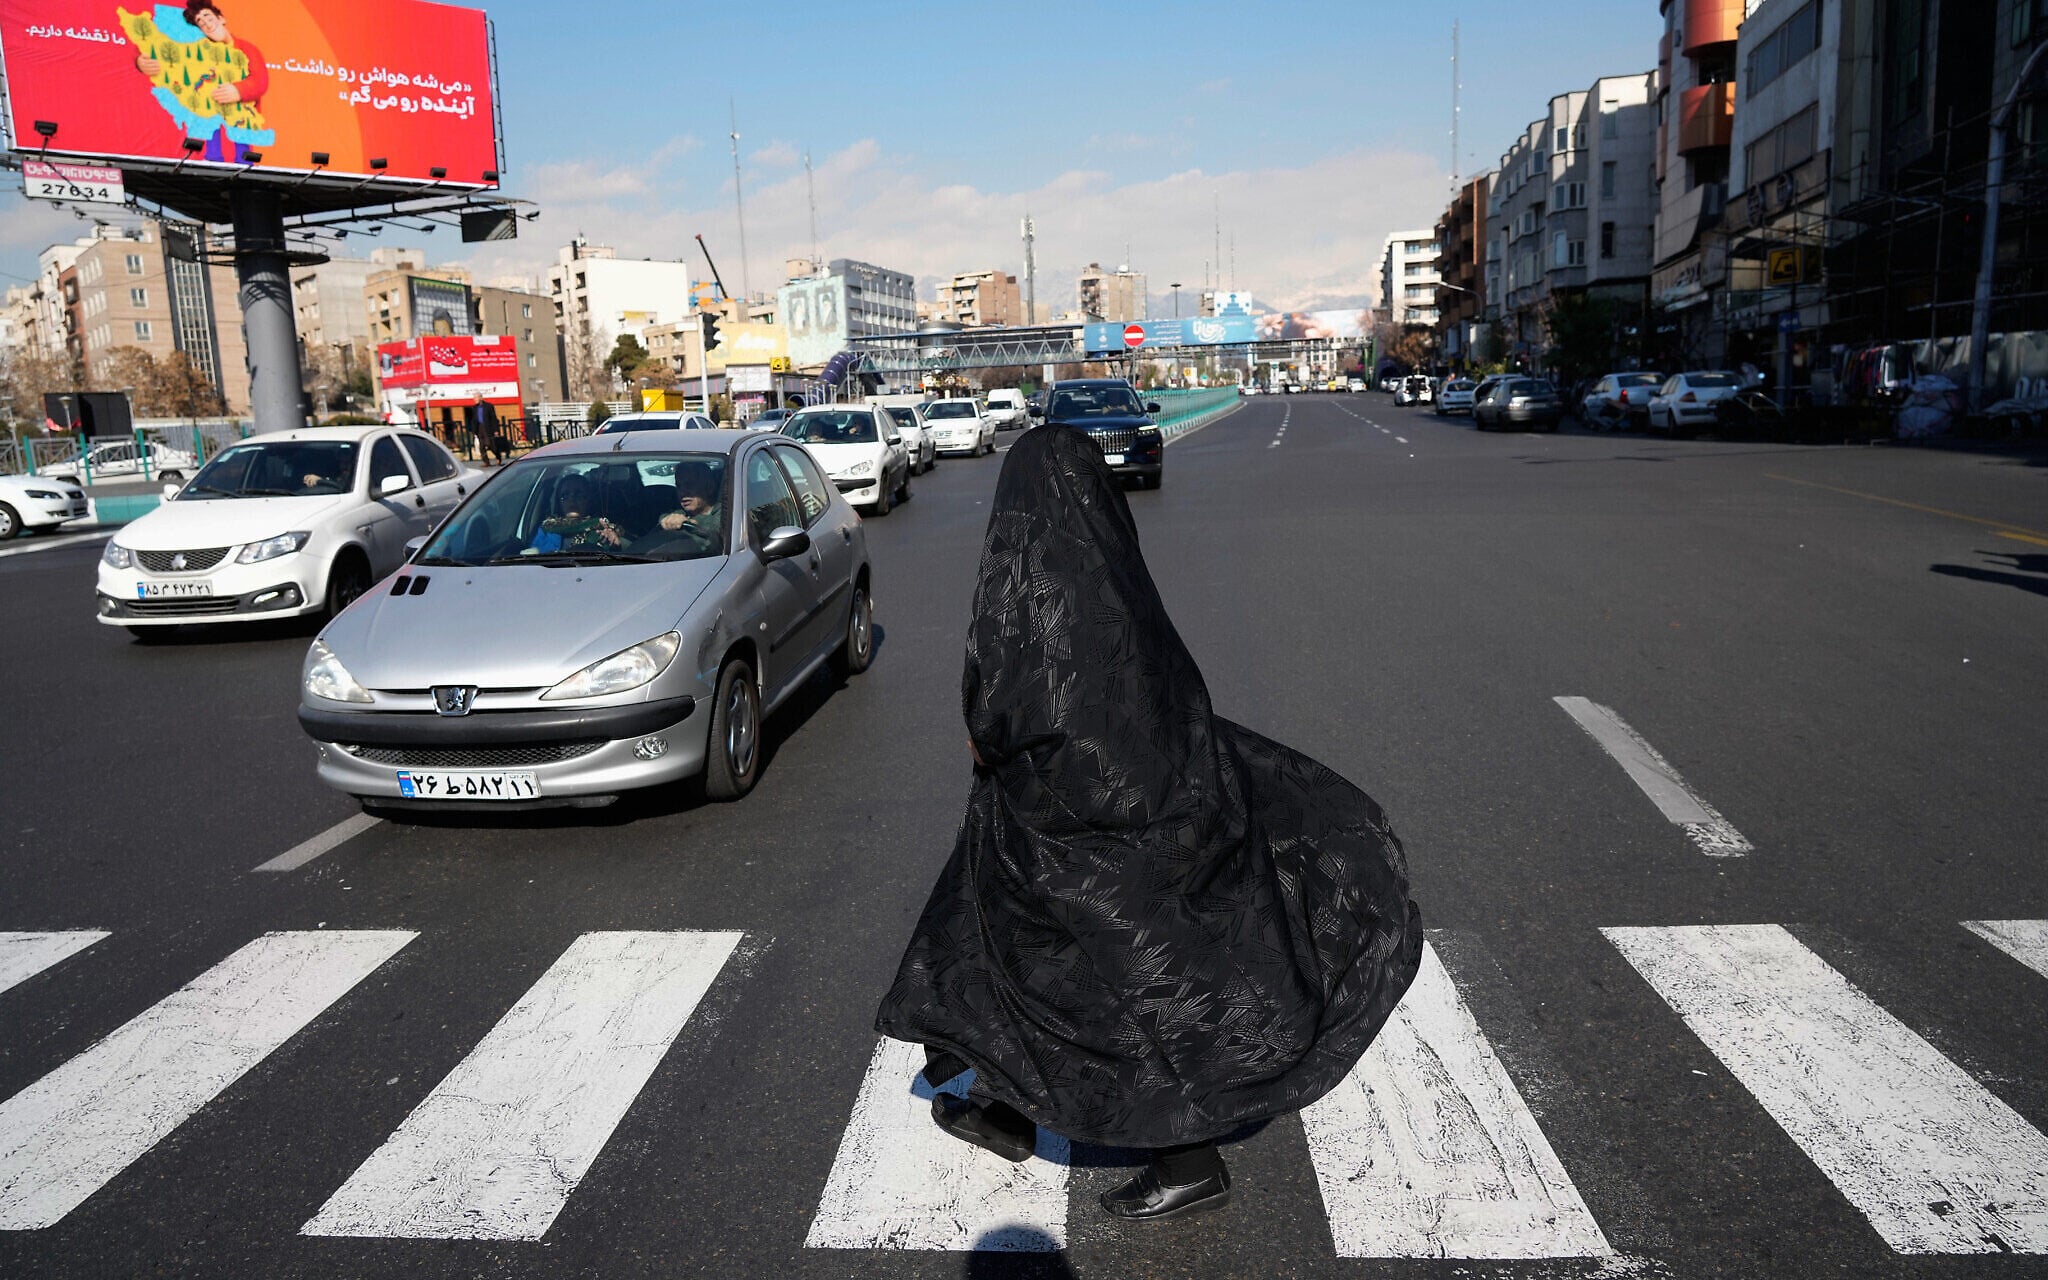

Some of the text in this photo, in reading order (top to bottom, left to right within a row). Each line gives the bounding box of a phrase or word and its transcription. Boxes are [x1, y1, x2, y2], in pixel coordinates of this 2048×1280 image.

[25, 24, 126, 45] ما نقشه داریم.
[284, 59, 334, 76] داشت
[337, 67, 356, 82] رو
[360, 67, 410, 88] هواش
[400, 97, 419, 113] رو
[421, 96, 475, 119] آینده
[413, 775, 438, 794] ۲۶
[465, 776, 503, 796] ۵۸۲
[510, 780, 534, 797] ۱۱
